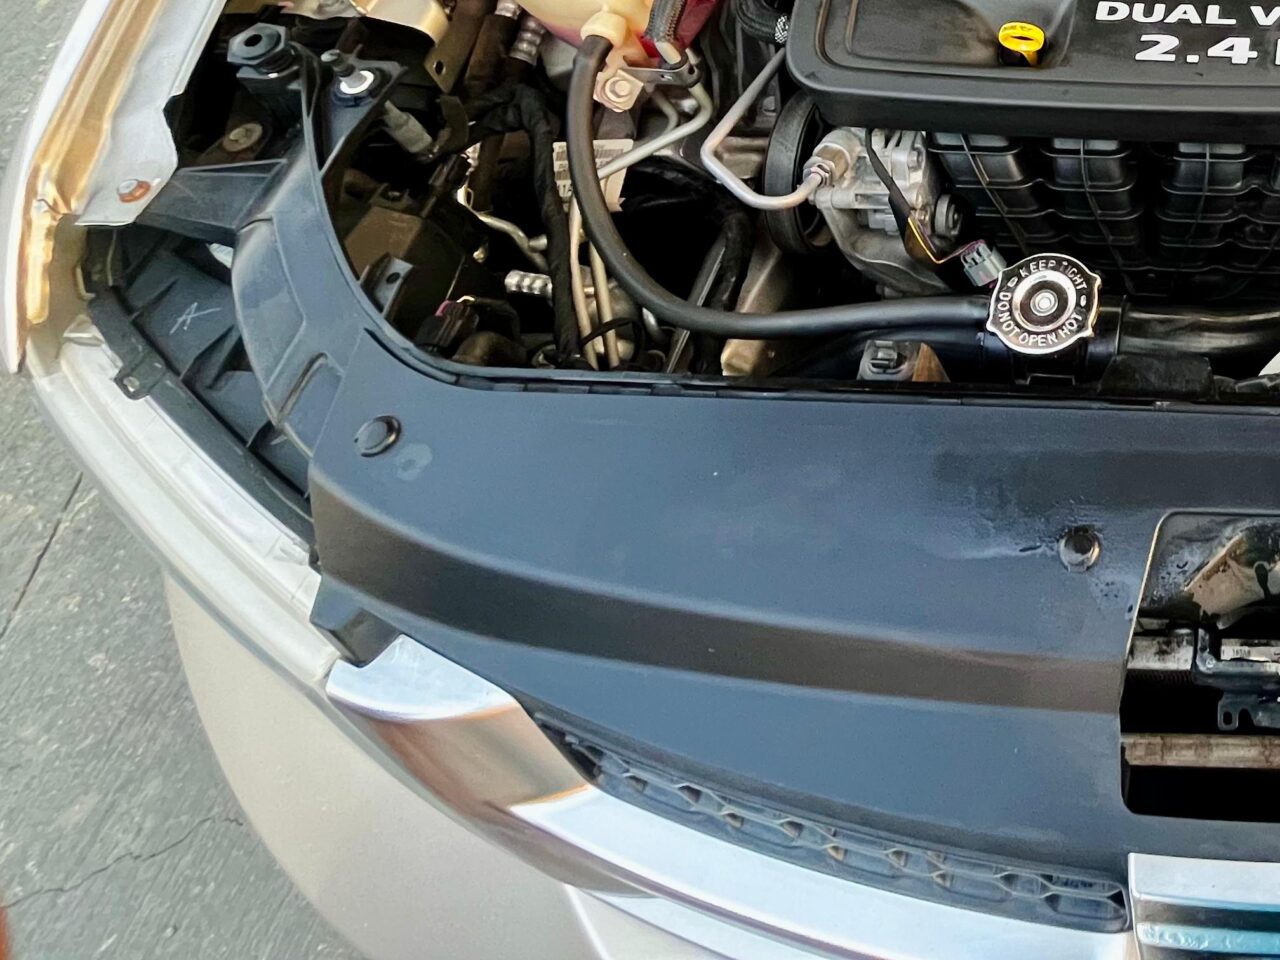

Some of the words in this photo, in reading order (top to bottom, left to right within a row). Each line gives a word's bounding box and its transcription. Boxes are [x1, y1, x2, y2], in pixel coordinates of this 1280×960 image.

[1095, 0, 1237, 25] DUAL
[1019, 259, 1057, 278] KEEP
[997, 291, 1012, 311] DO
[998, 311, 1021, 337] NOT
[1057, 311, 1082, 338] HOT
[1018, 332, 1058, 346] OPEN
